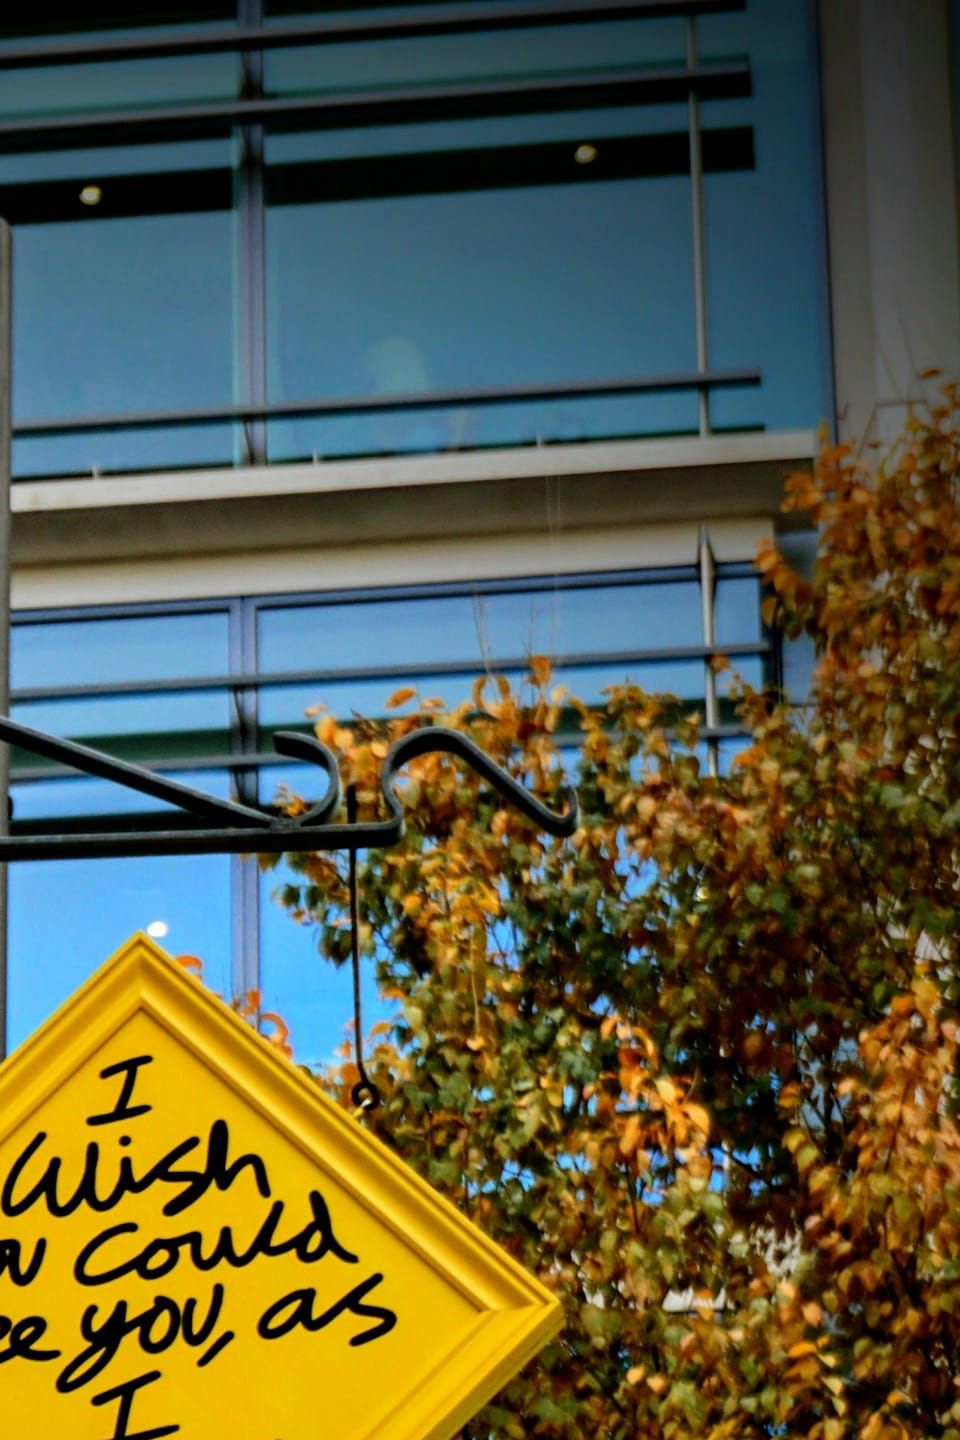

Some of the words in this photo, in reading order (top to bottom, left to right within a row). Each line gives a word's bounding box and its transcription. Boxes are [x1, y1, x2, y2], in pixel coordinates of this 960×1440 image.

[86, 1055, 154, 1127] I
[55, 1283, 235, 1394] you,
[257, 1272, 398, 1347] as
